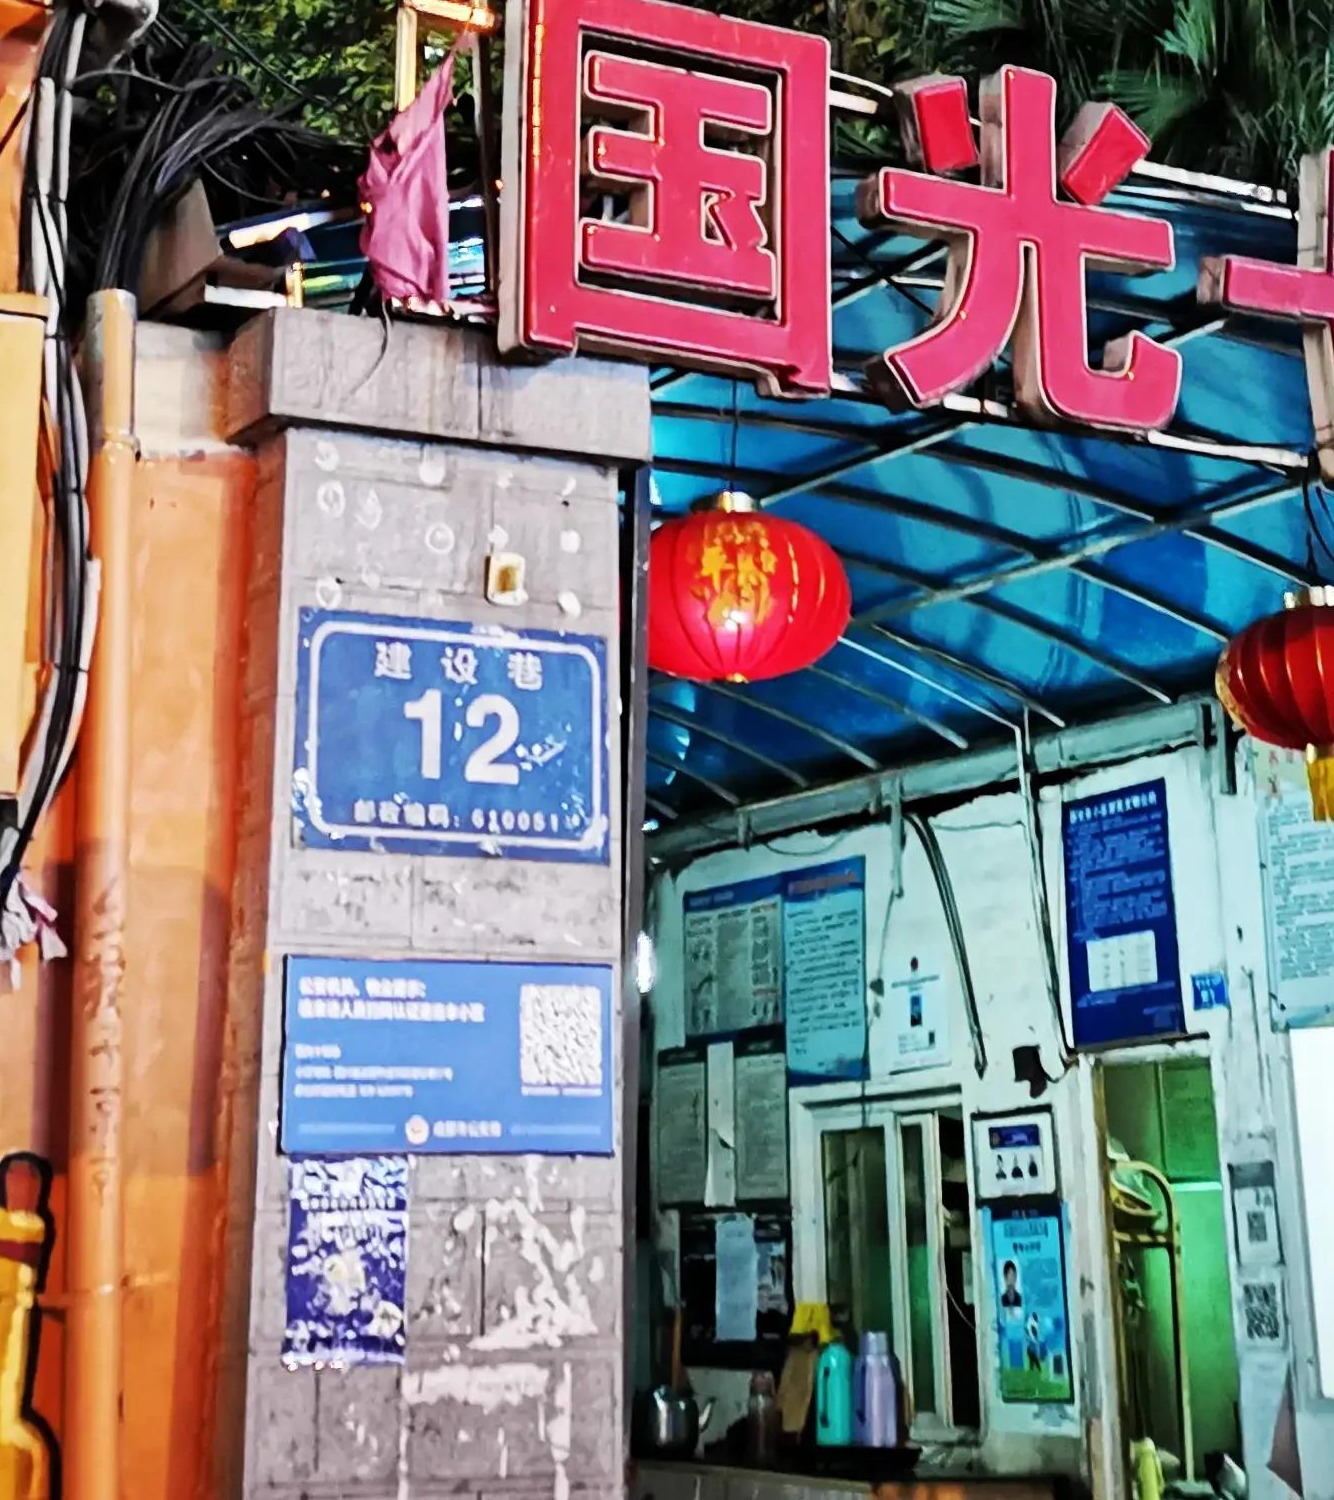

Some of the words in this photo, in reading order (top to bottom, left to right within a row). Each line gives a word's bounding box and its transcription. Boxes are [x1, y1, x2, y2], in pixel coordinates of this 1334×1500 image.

[374, 642, 544, 691] 建设巷
[404, 688, 521, 786] 12
